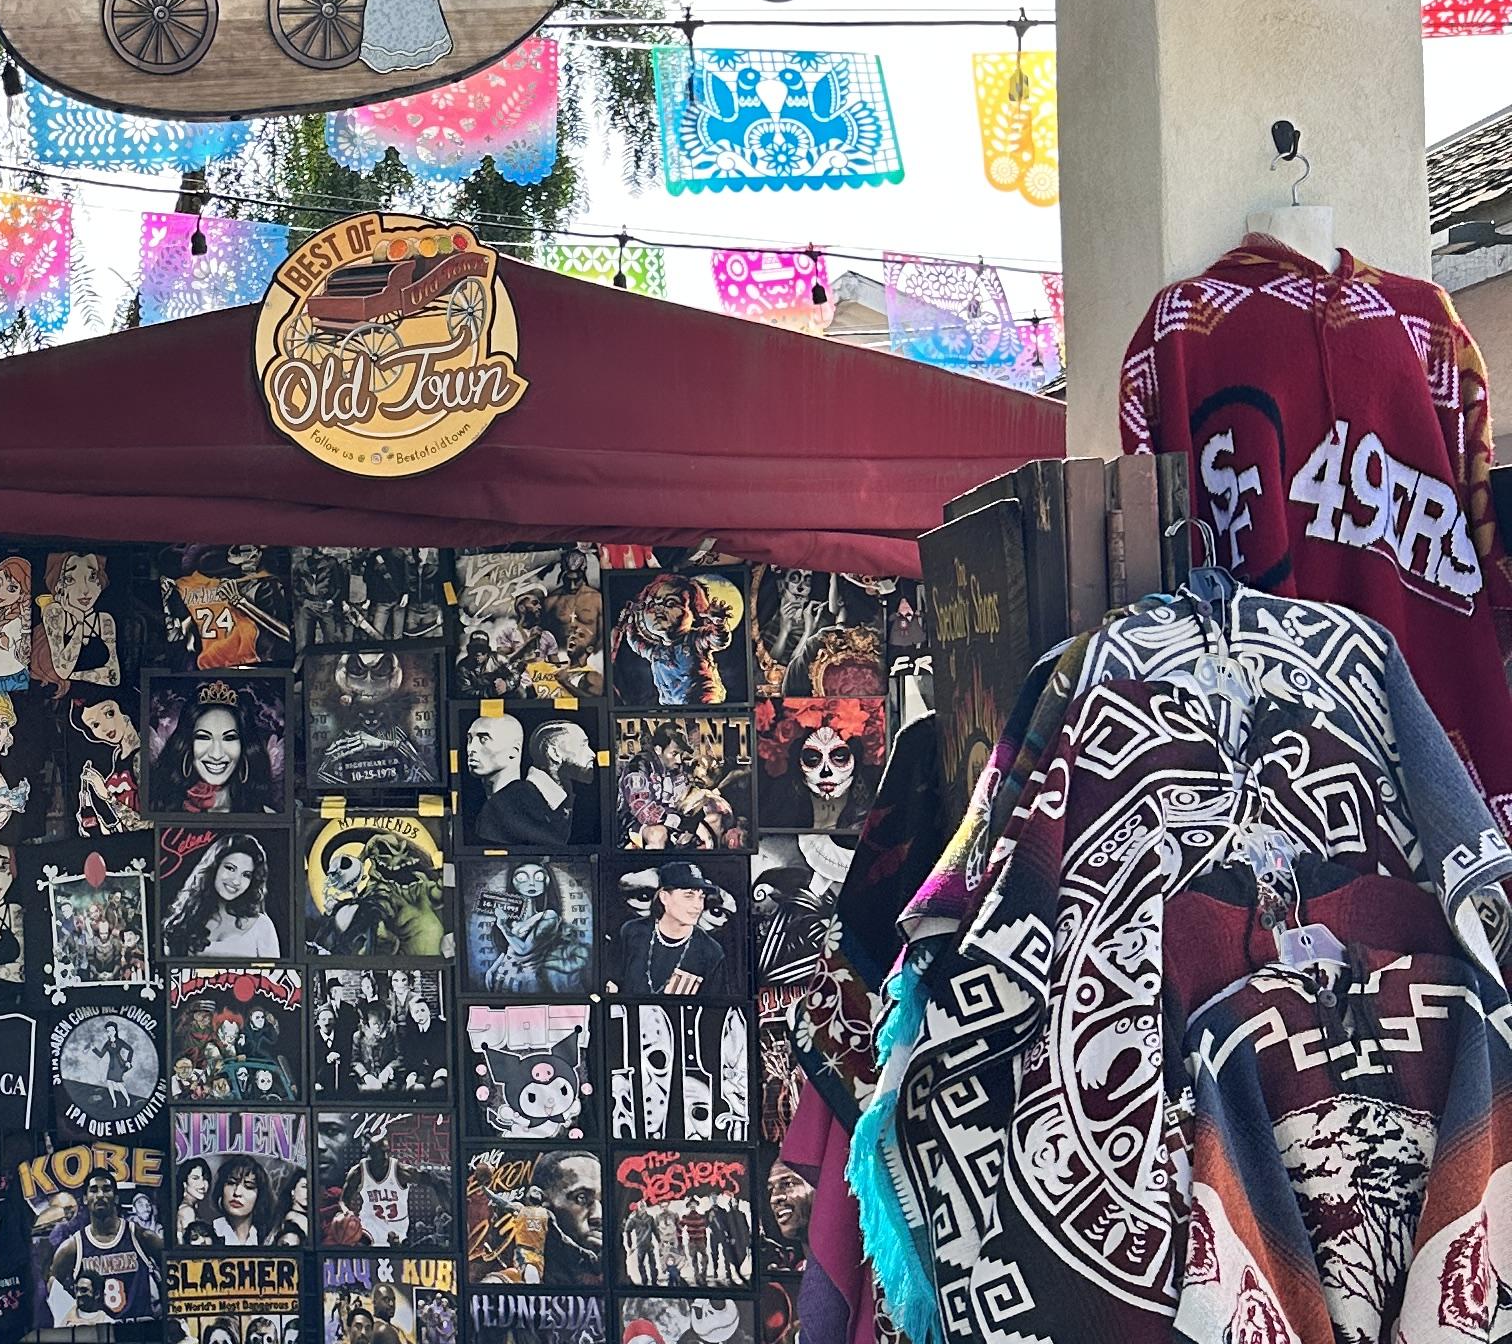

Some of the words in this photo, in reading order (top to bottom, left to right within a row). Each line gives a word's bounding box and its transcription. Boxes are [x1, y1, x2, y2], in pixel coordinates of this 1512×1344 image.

[284, 232, 342, 293] BEST
[346, 219, 377, 255] OF
[273, 355, 373, 426] Old
[378, 330, 513, 415] Town
[310, 428, 341, 454] Follow
[195, 606, 235, 639] 24
[88, 1119, 113, 1137] QUE
[115, 1118, 136, 1136] ME
[18, 1141, 166, 1199] KOBE
[372, 1203, 399, 1220] 23
[377, 1258, 395, 1283] &
[104, 1277, 127, 1313] 8
[168, 1302, 182, 1313] The
[184, 1301, 216, 1312] World's
[219, 1300, 240, 1311] Most
